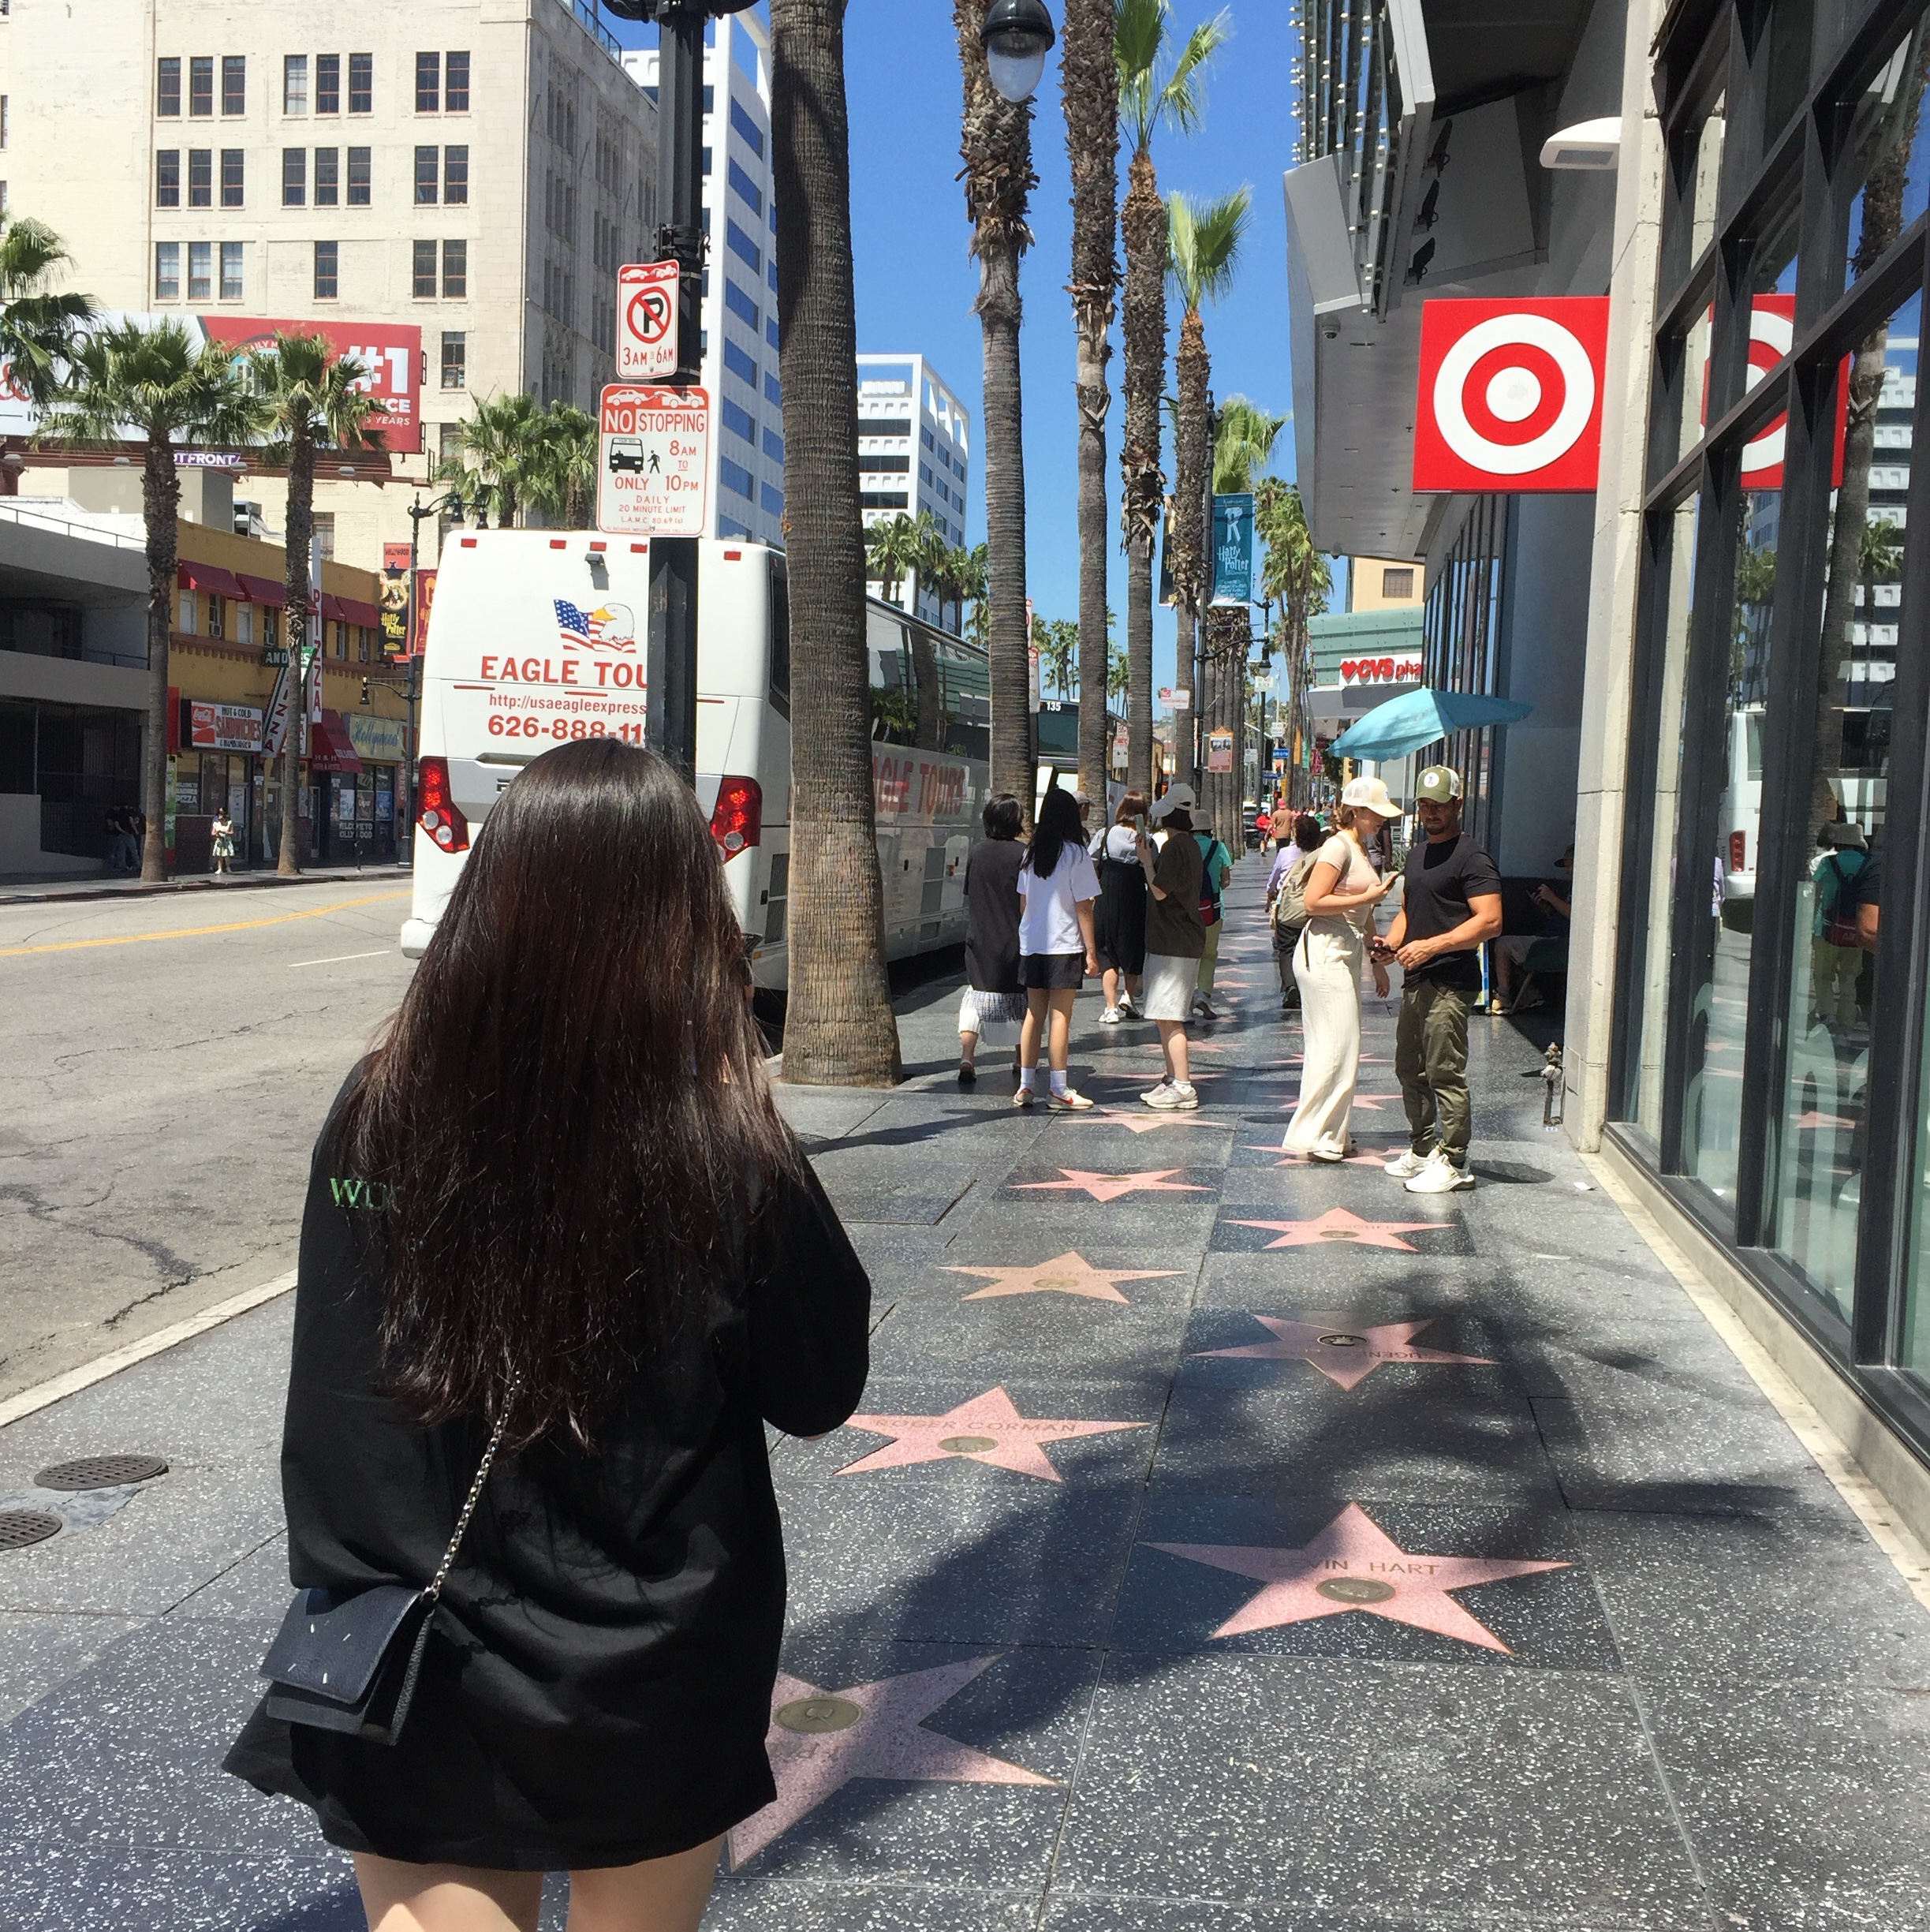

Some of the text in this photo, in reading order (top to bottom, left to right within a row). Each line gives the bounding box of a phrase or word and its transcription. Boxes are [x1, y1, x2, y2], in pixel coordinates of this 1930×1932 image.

[375, 416, 410, 426] YEARS
[605, 409, 705, 433] NO STOPPING
[670, 439, 696, 456] 8AM
[678, 460, 689, 469] TO
[614, 476, 649, 491] ONLY
[666, 474, 699, 491] 10PM
[636, 495, 670, 504] DAILY
[633, 505, 663, 514] MINUTE
[1217, 545, 1241, 562] Harry
[1225, 557, 1249, 574] Potter
[381, 612, 401, 626] Harry
[386, 622, 406, 637] Potter
[481, 656, 580, 685] EAGLE
[1357, 658, 1395, 678] CVS
[489, 693, 648, 716] http://usaeagleexpress
[1047, 701, 1062, 712] 135
[222, 707, 233, 716] HOT
[237, 709, 252, 719] COLD
[216, 716, 262, 742] SANDWICHES
[487, 714, 648, 745] 626-888-11
[875, 1418, 1077, 1433] ROGER CORMAN
[1369, 1561, 1441, 1575] HART
